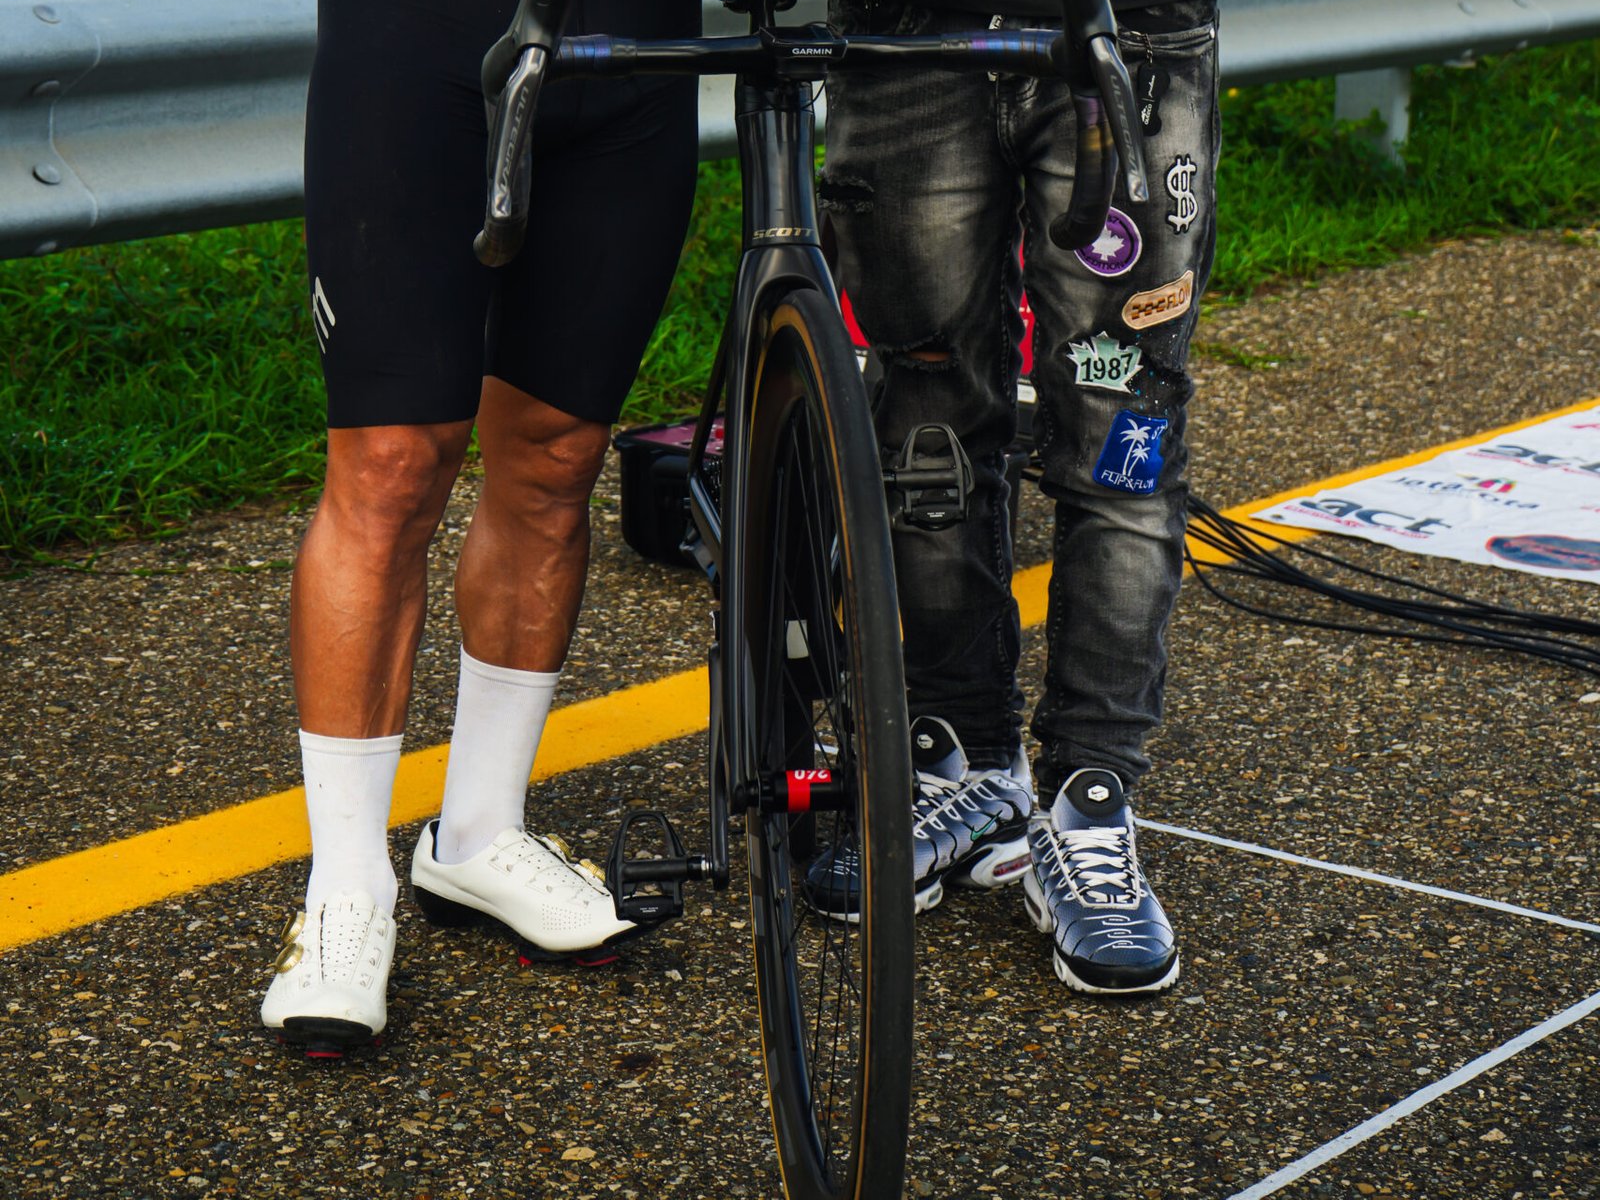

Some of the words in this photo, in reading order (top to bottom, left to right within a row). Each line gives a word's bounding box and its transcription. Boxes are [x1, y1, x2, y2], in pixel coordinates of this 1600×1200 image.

[791, 47, 833, 56] GARMIN
[499, 85, 529, 190] ULTEGRA
[1110, 74, 1140, 178] ULTEGRA
[752, 226, 815, 240] SCOTT
[1080, 353, 1134, 383] 1987
